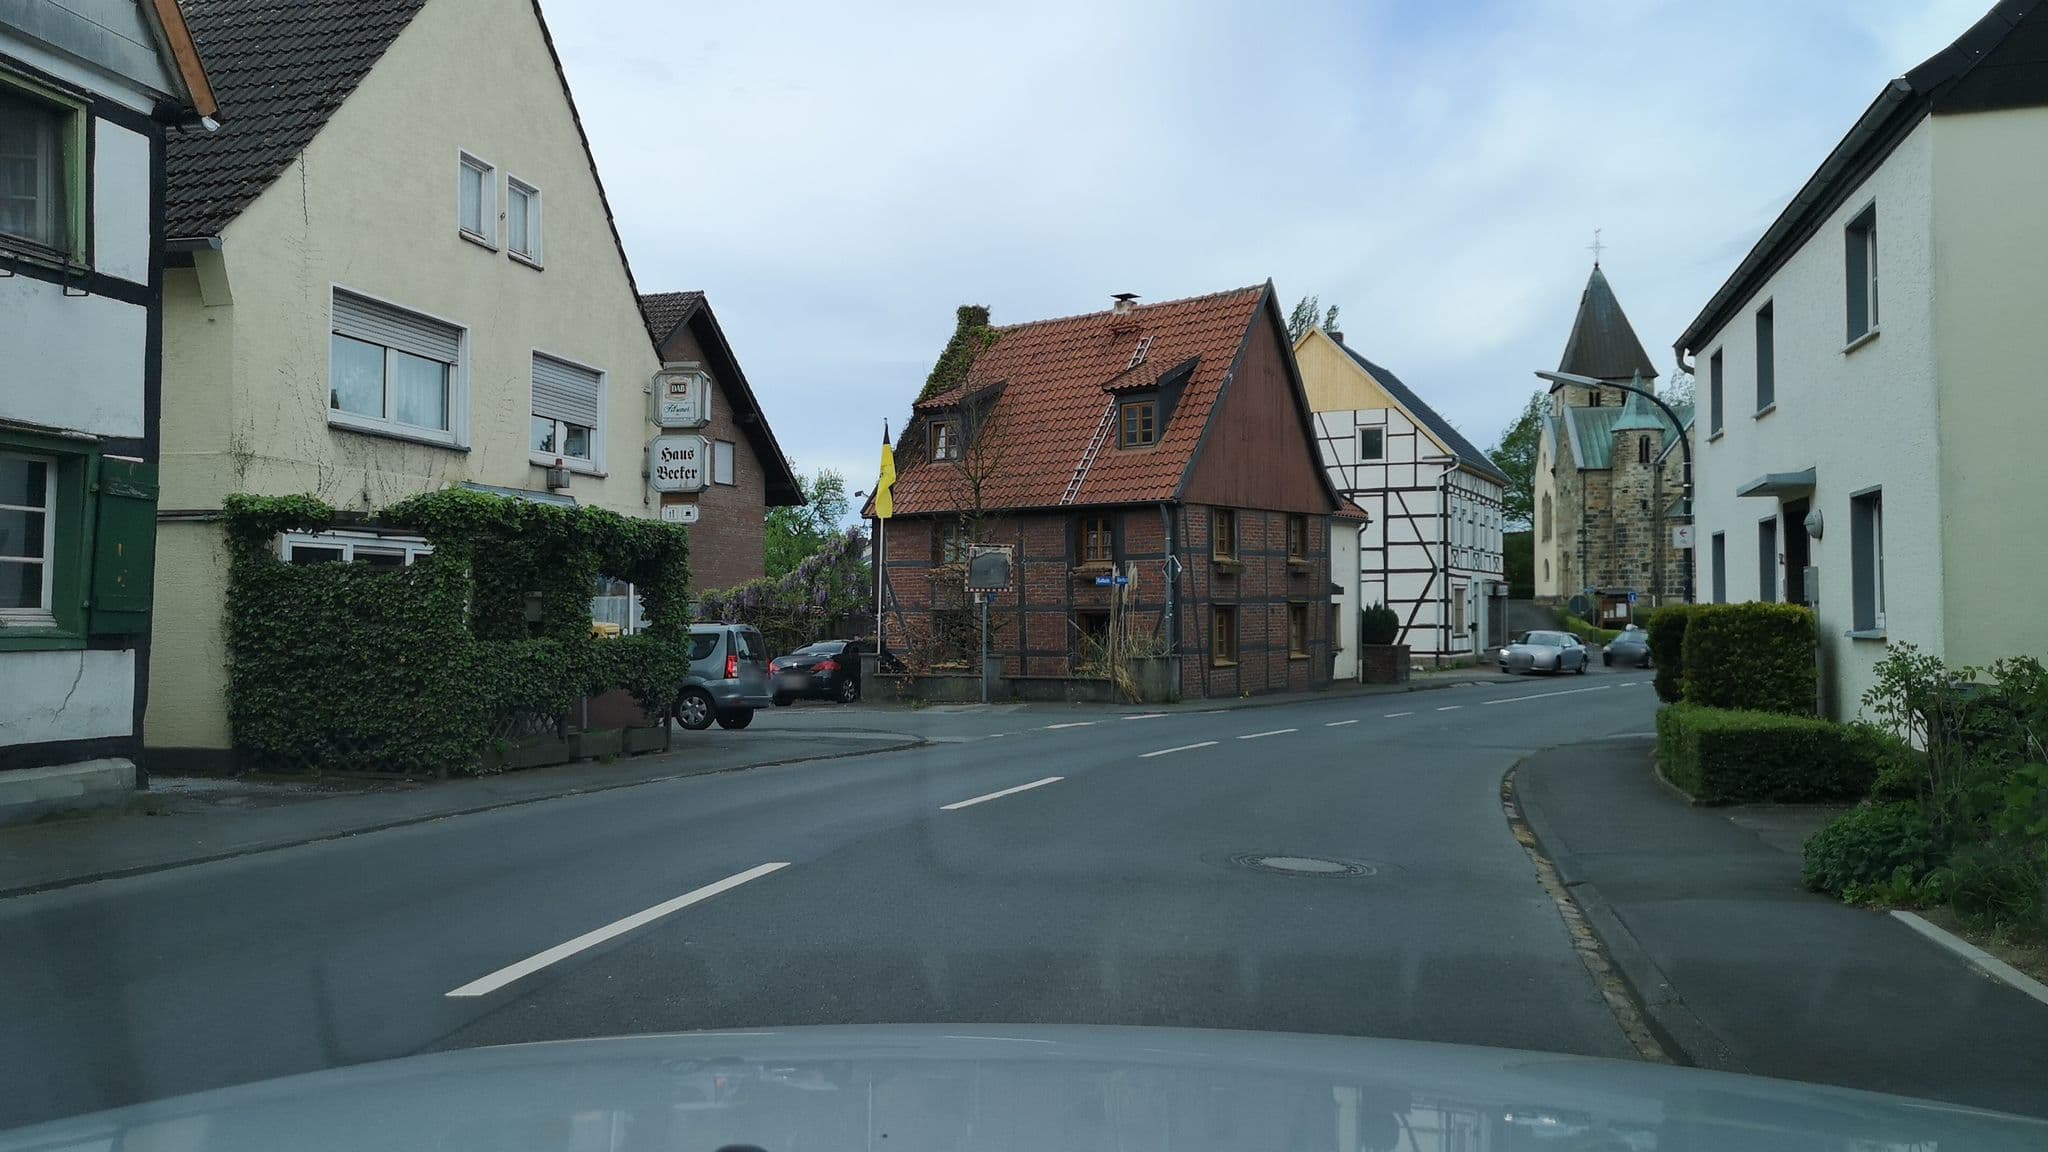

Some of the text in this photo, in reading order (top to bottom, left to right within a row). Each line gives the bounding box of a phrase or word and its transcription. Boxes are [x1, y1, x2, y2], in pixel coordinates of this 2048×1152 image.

[671, 384, 686, 393] DAB
[661, 447, 694, 463] Haus
[656, 465, 698, 480] Becker
